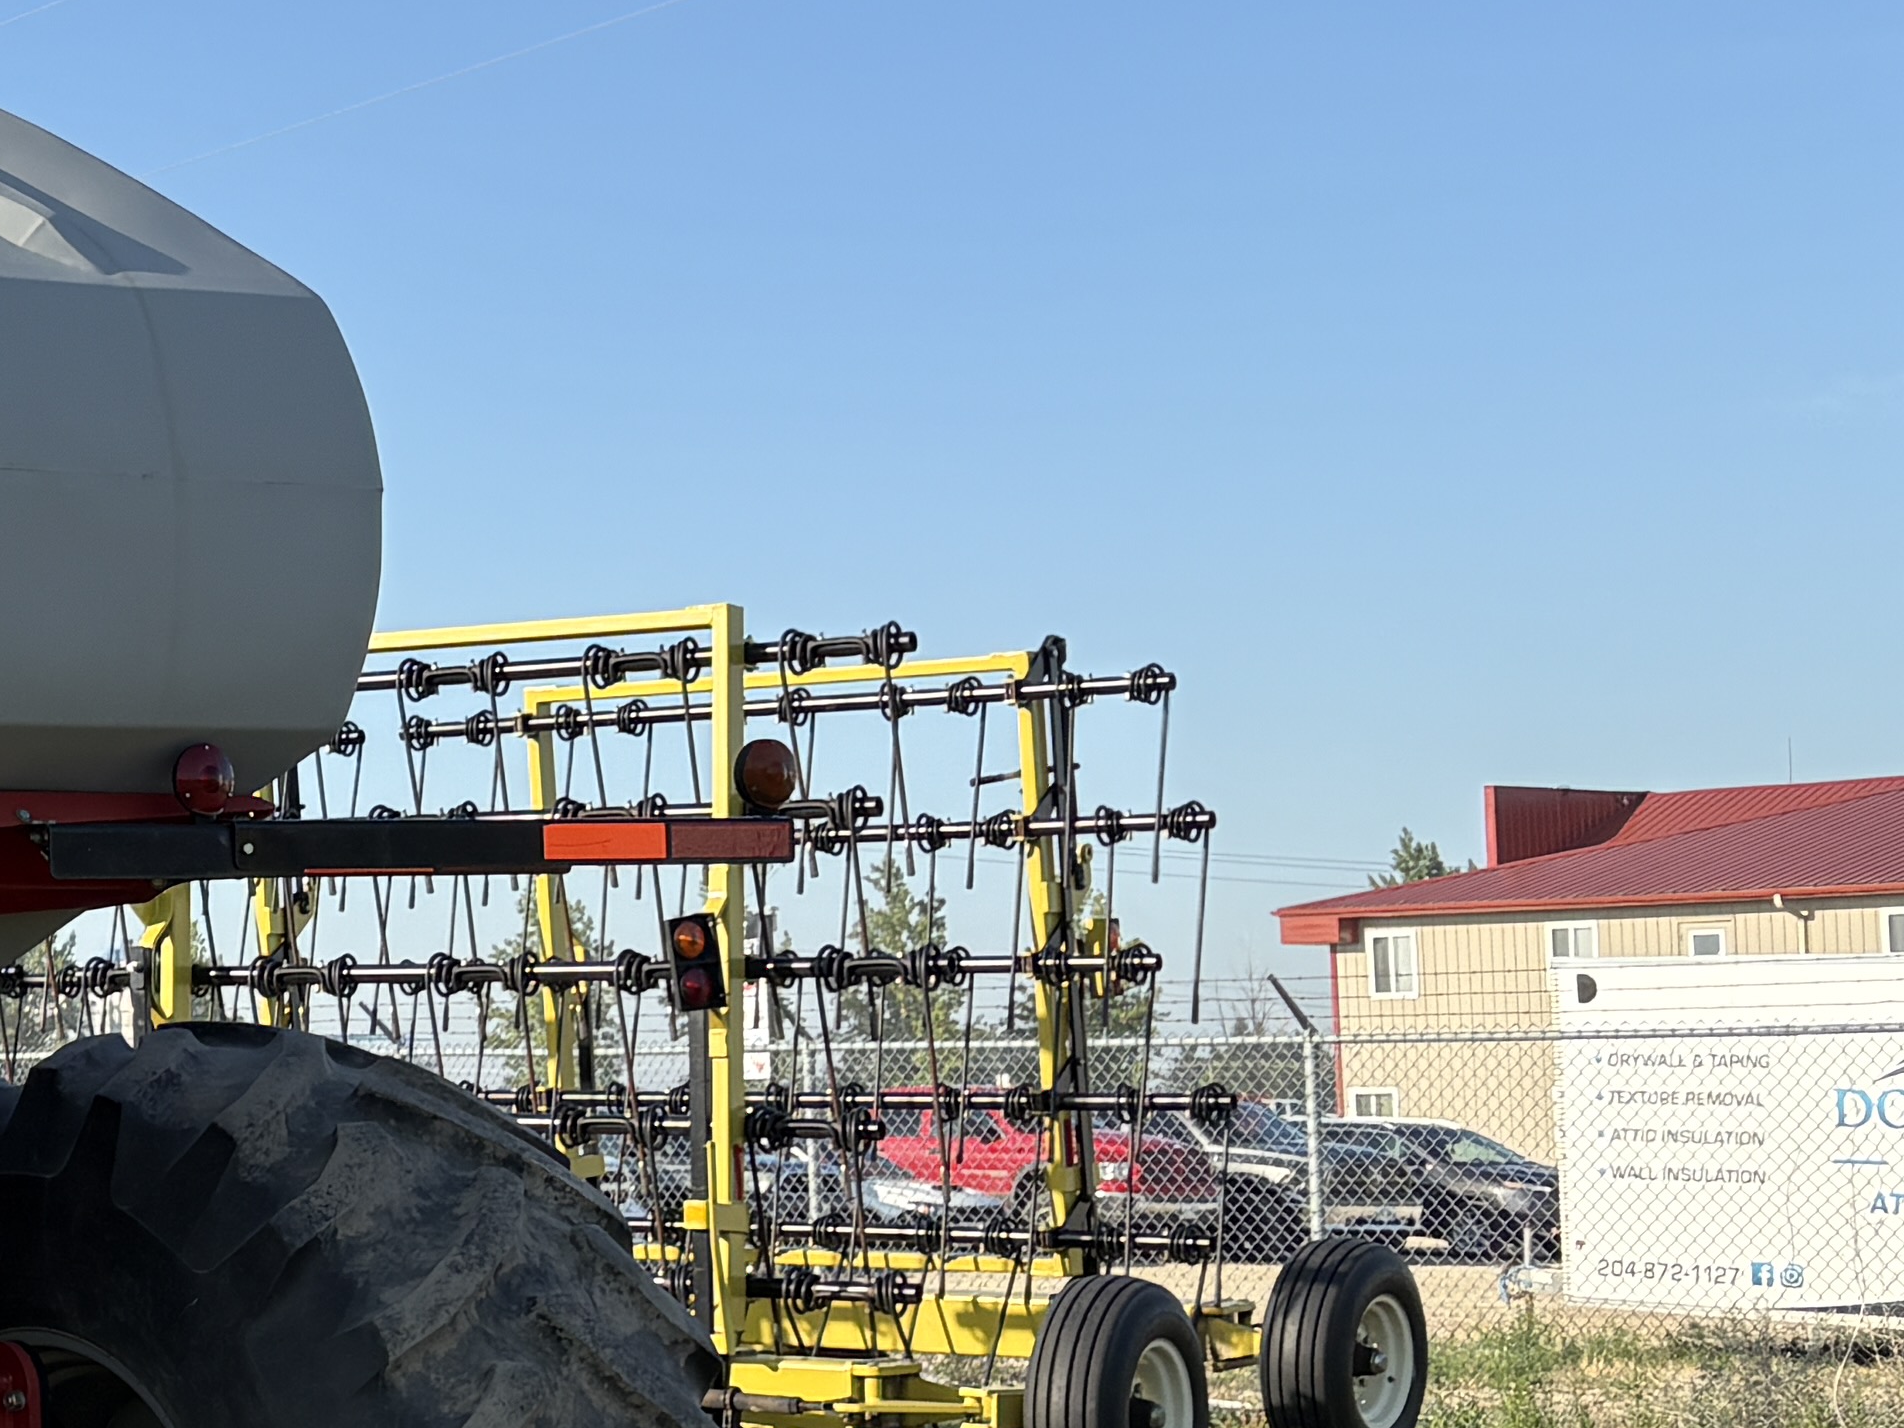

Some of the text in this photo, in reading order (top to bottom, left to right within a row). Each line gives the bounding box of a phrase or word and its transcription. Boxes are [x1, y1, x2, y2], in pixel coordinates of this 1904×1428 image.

[1607, 1053, 1687, 1068] DRYWALL
[1709, 1054, 1770, 1069] TAPING
[1608, 1091, 1765, 1107] TEXTURE REMOVAL
[1662, 1129, 1766, 1146] INSULATION
[1610, 1164, 1766, 1184] WALL INSULATION
[1598, 1258, 1740, 1285] 204-872-1127
